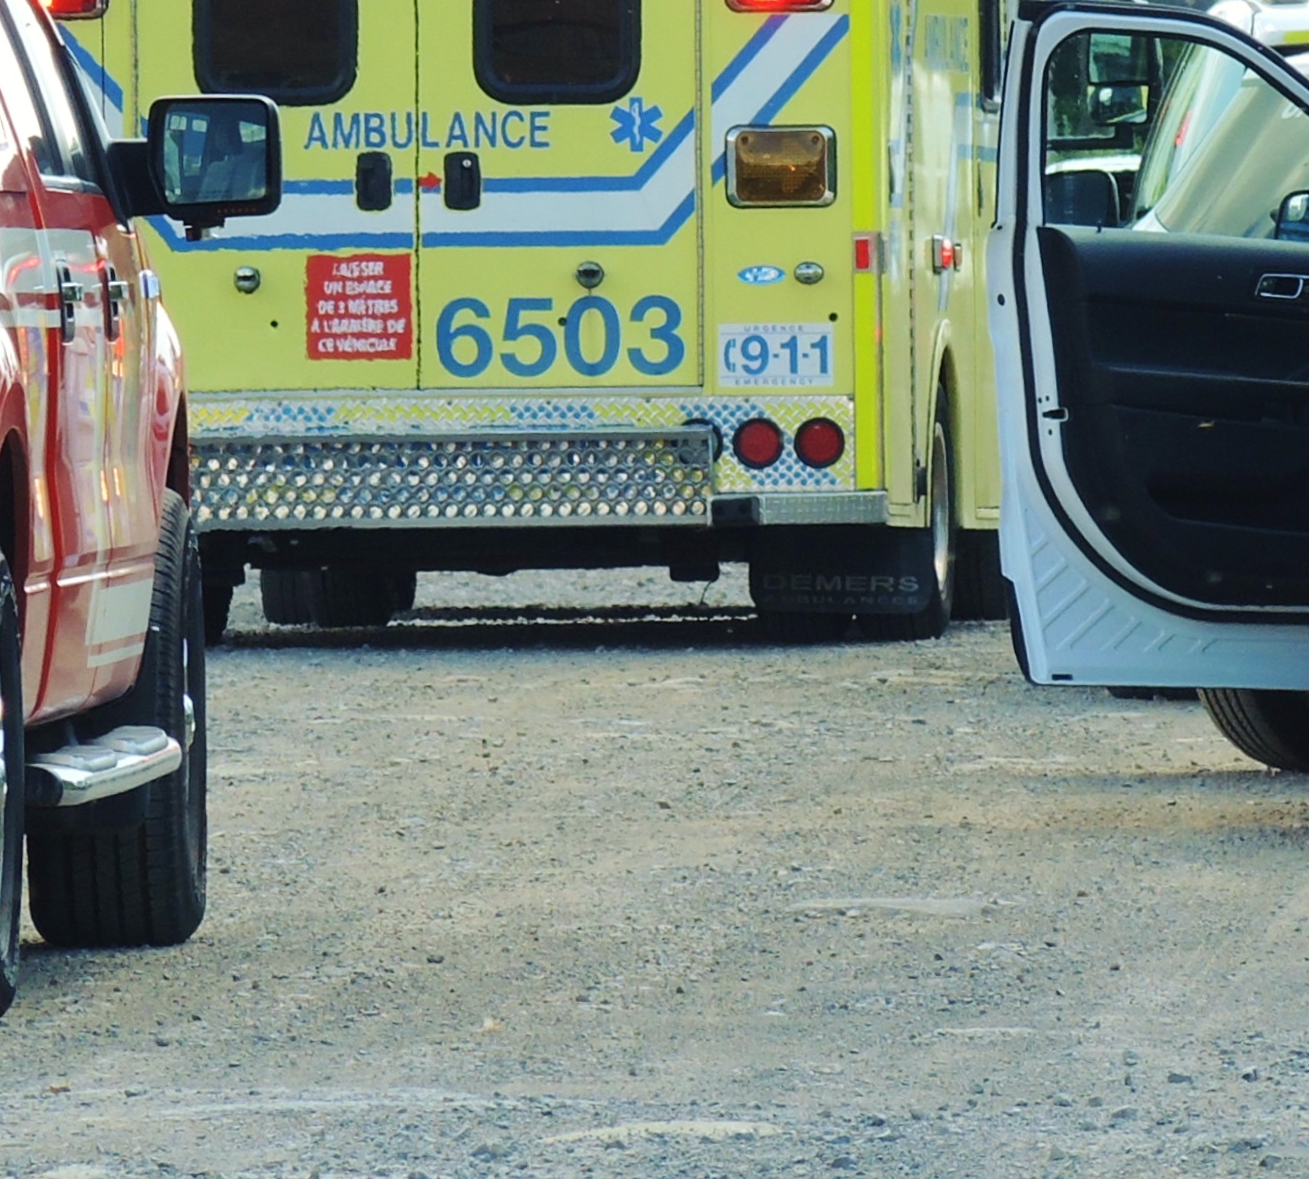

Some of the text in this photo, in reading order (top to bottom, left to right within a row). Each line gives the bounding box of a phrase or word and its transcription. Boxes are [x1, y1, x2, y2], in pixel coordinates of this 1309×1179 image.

[303, 110, 551, 150] AMBULANCE
[436, 295, 685, 378] 6503
[740, 334, 829, 376] 9-1-1
[735, 378, 814, 386] EMERGENCY
[763, 574, 920, 593] DEMERS
